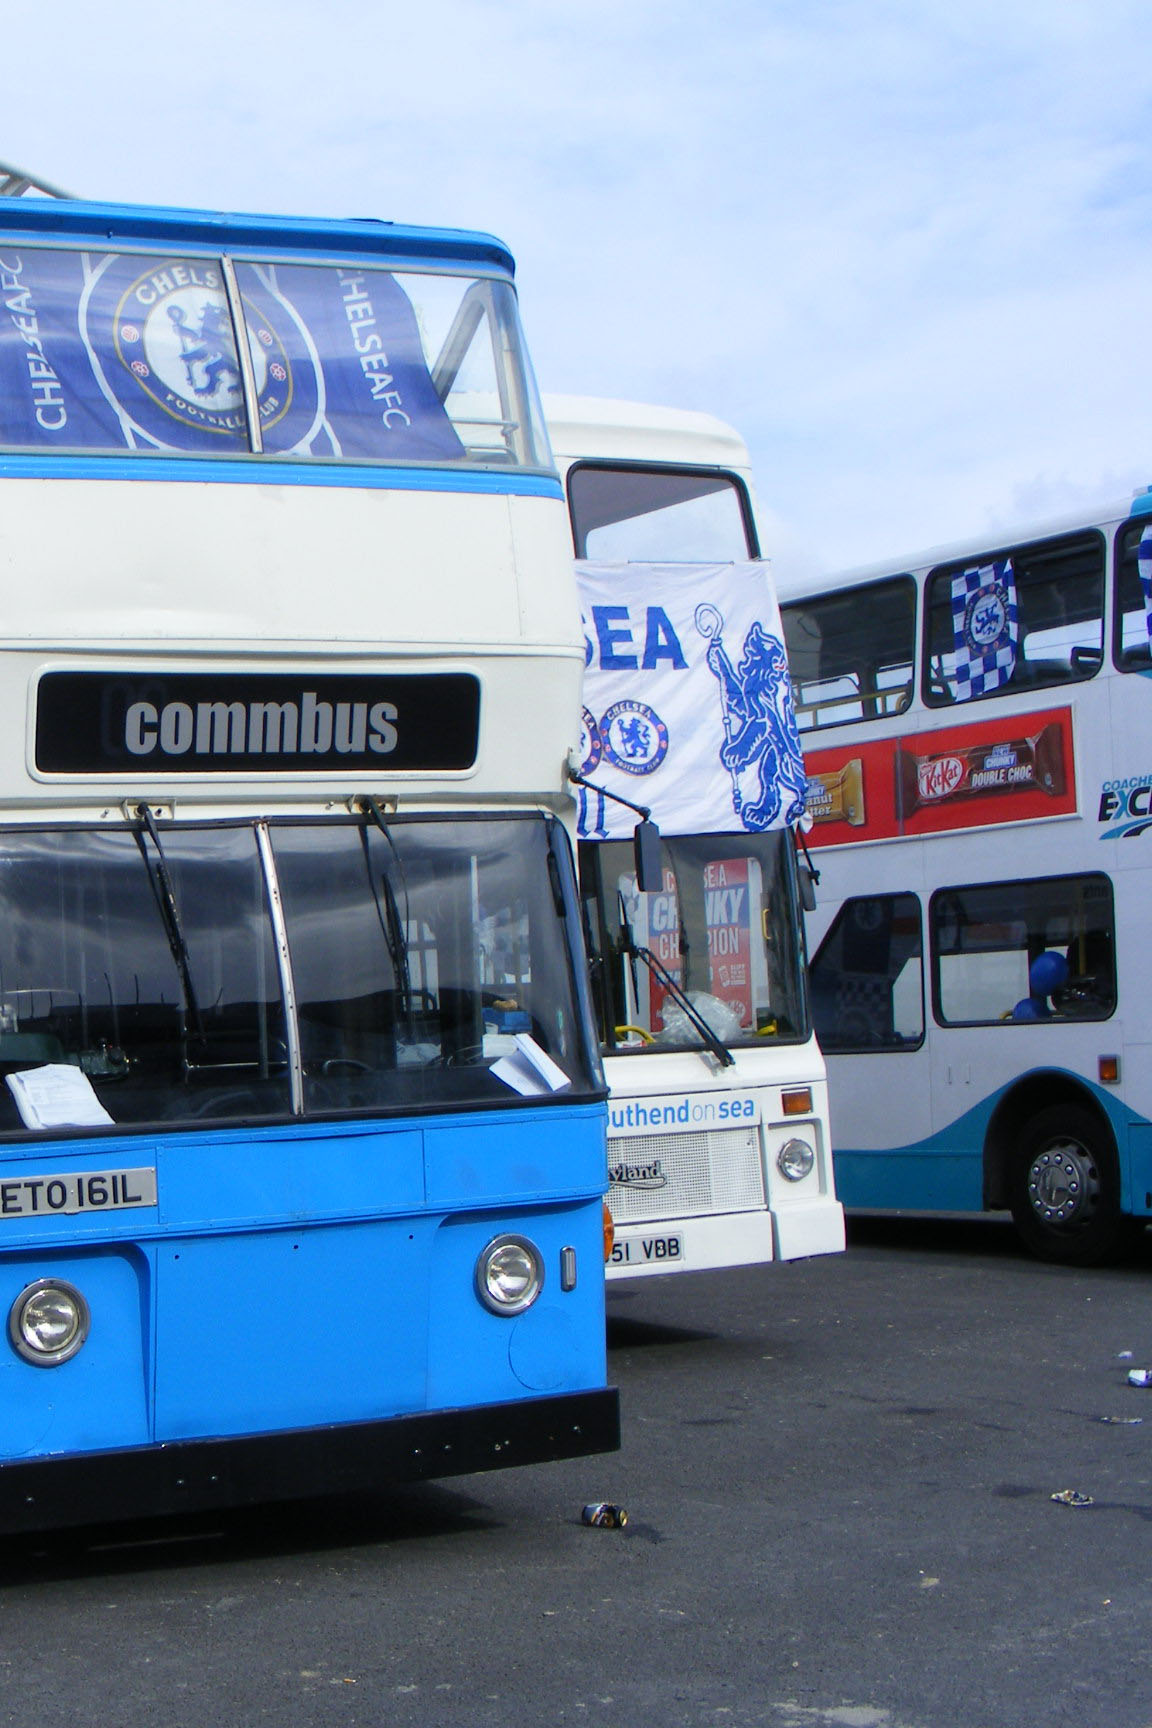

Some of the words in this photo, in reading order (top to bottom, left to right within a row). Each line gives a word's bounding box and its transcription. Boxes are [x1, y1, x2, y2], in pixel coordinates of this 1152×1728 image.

[135, 264, 219, 305] CHELS
[259, 396, 280, 417] LUB
[124, 692, 399, 755] commbus
[607, 702, 651, 721] CHELSEA
[924, 760, 958, 795] KitKat
[972, 769, 1006, 788] DOUBLE
[1007, 765, 1033, 784] CHOC
[805, 793, 833, 806] anut
[808, 805, 832, 818] tter
[1098, 786, 1152, 822] EXC
[608, 1160, 662, 1181] yland
[1, 1180, 68, 1214] ETO
[77, 1174, 143, 1208] 161L
[605, 1243, 630, 1264] 51
[642, 1238, 681, 1260] VBB
